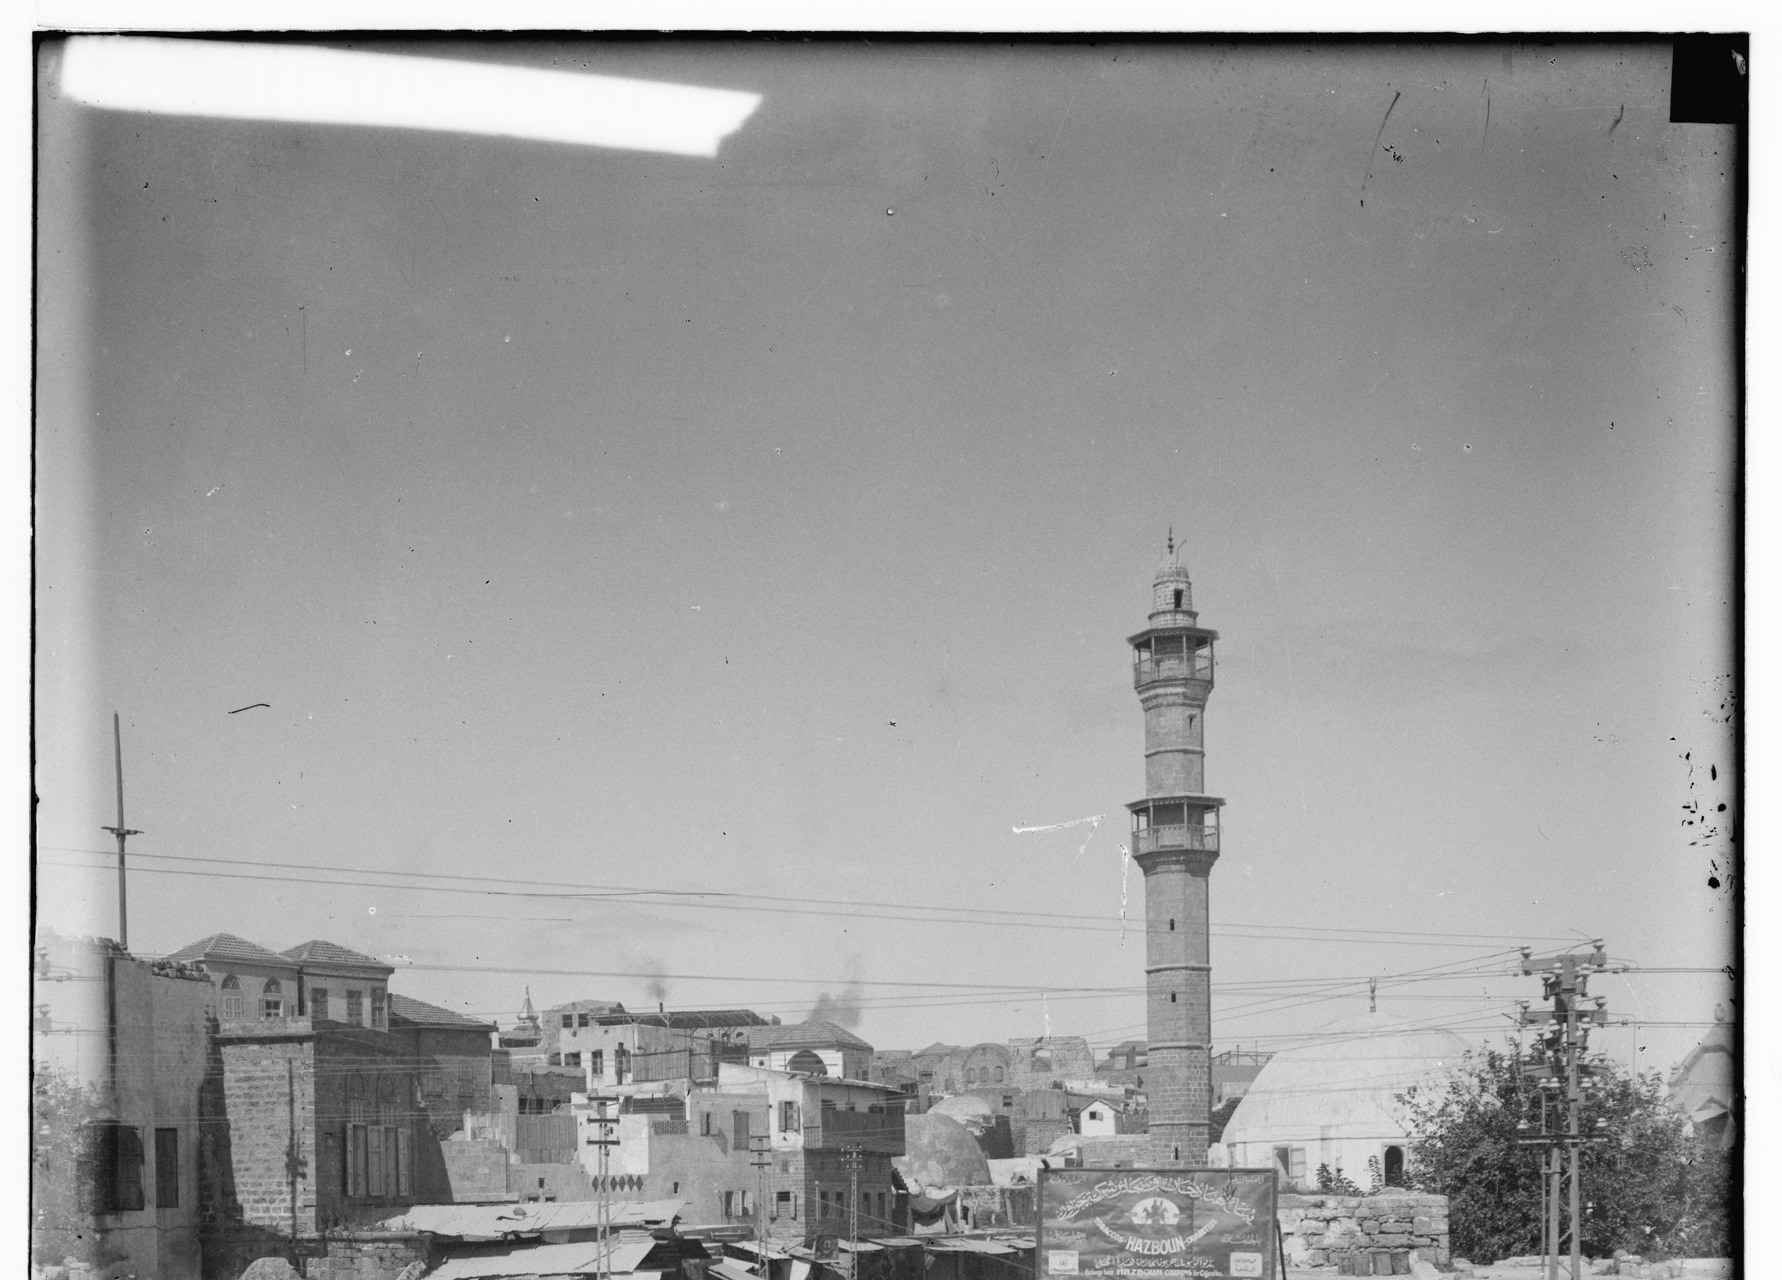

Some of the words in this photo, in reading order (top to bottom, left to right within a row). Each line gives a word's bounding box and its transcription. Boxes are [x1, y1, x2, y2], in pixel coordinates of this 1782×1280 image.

[1093, 1216, 1124, 1243] TOBACCOS
[1124, 1235, 1186, 1255] HAZBOUN
[1116, 1268, 1163, 1276] HAZBOUN
